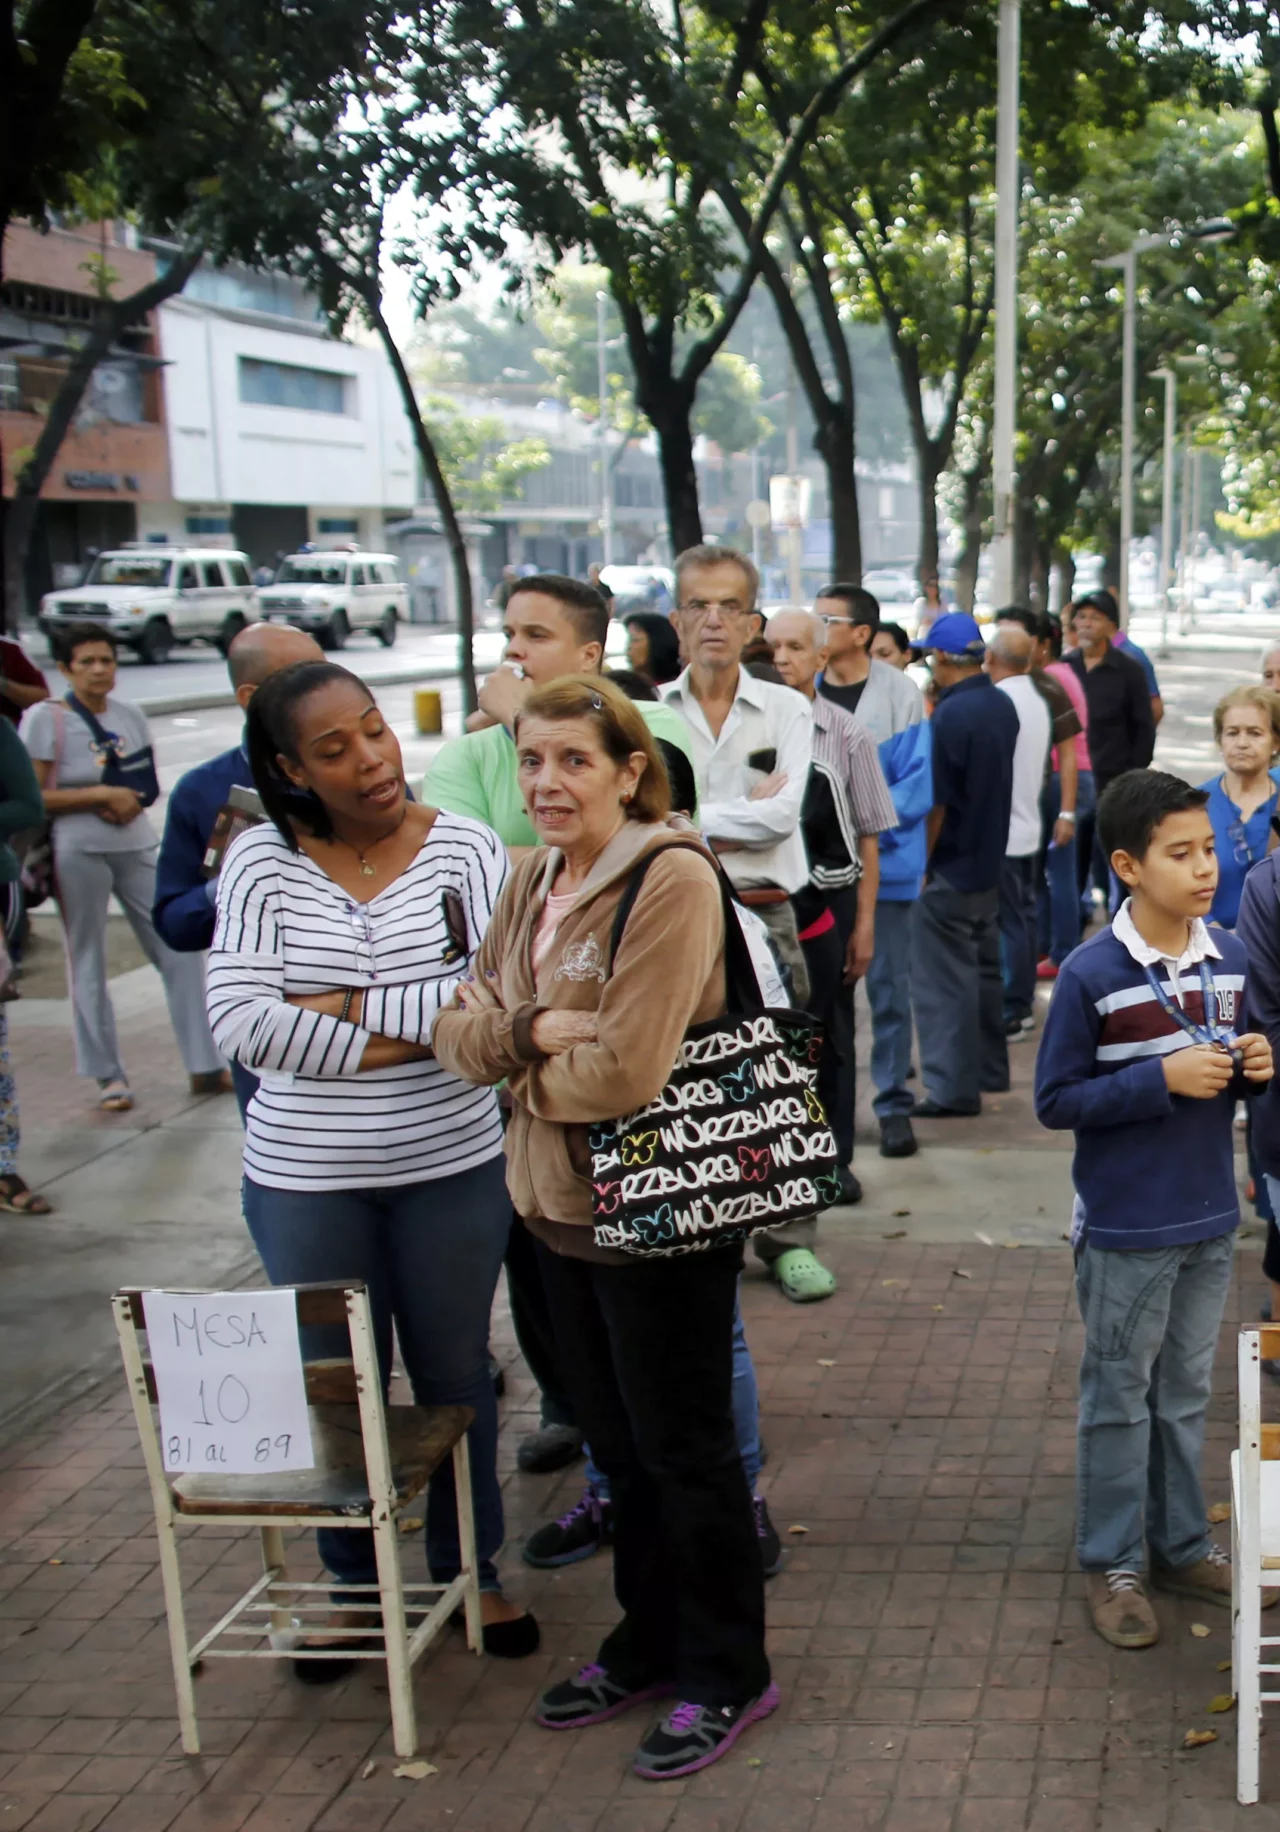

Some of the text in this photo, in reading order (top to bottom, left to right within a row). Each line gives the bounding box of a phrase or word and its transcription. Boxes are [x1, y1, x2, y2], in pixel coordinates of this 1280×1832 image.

[659, 1096, 808, 1153] WÜRZBURG
[673, 1176, 818, 1236] WÜRZBURG
[172, 1307, 268, 1356] MESA
[193, 1373, 251, 1426] 10
[167, 1435, 192, 1464] 81
[254, 1433, 292, 1463] 89
